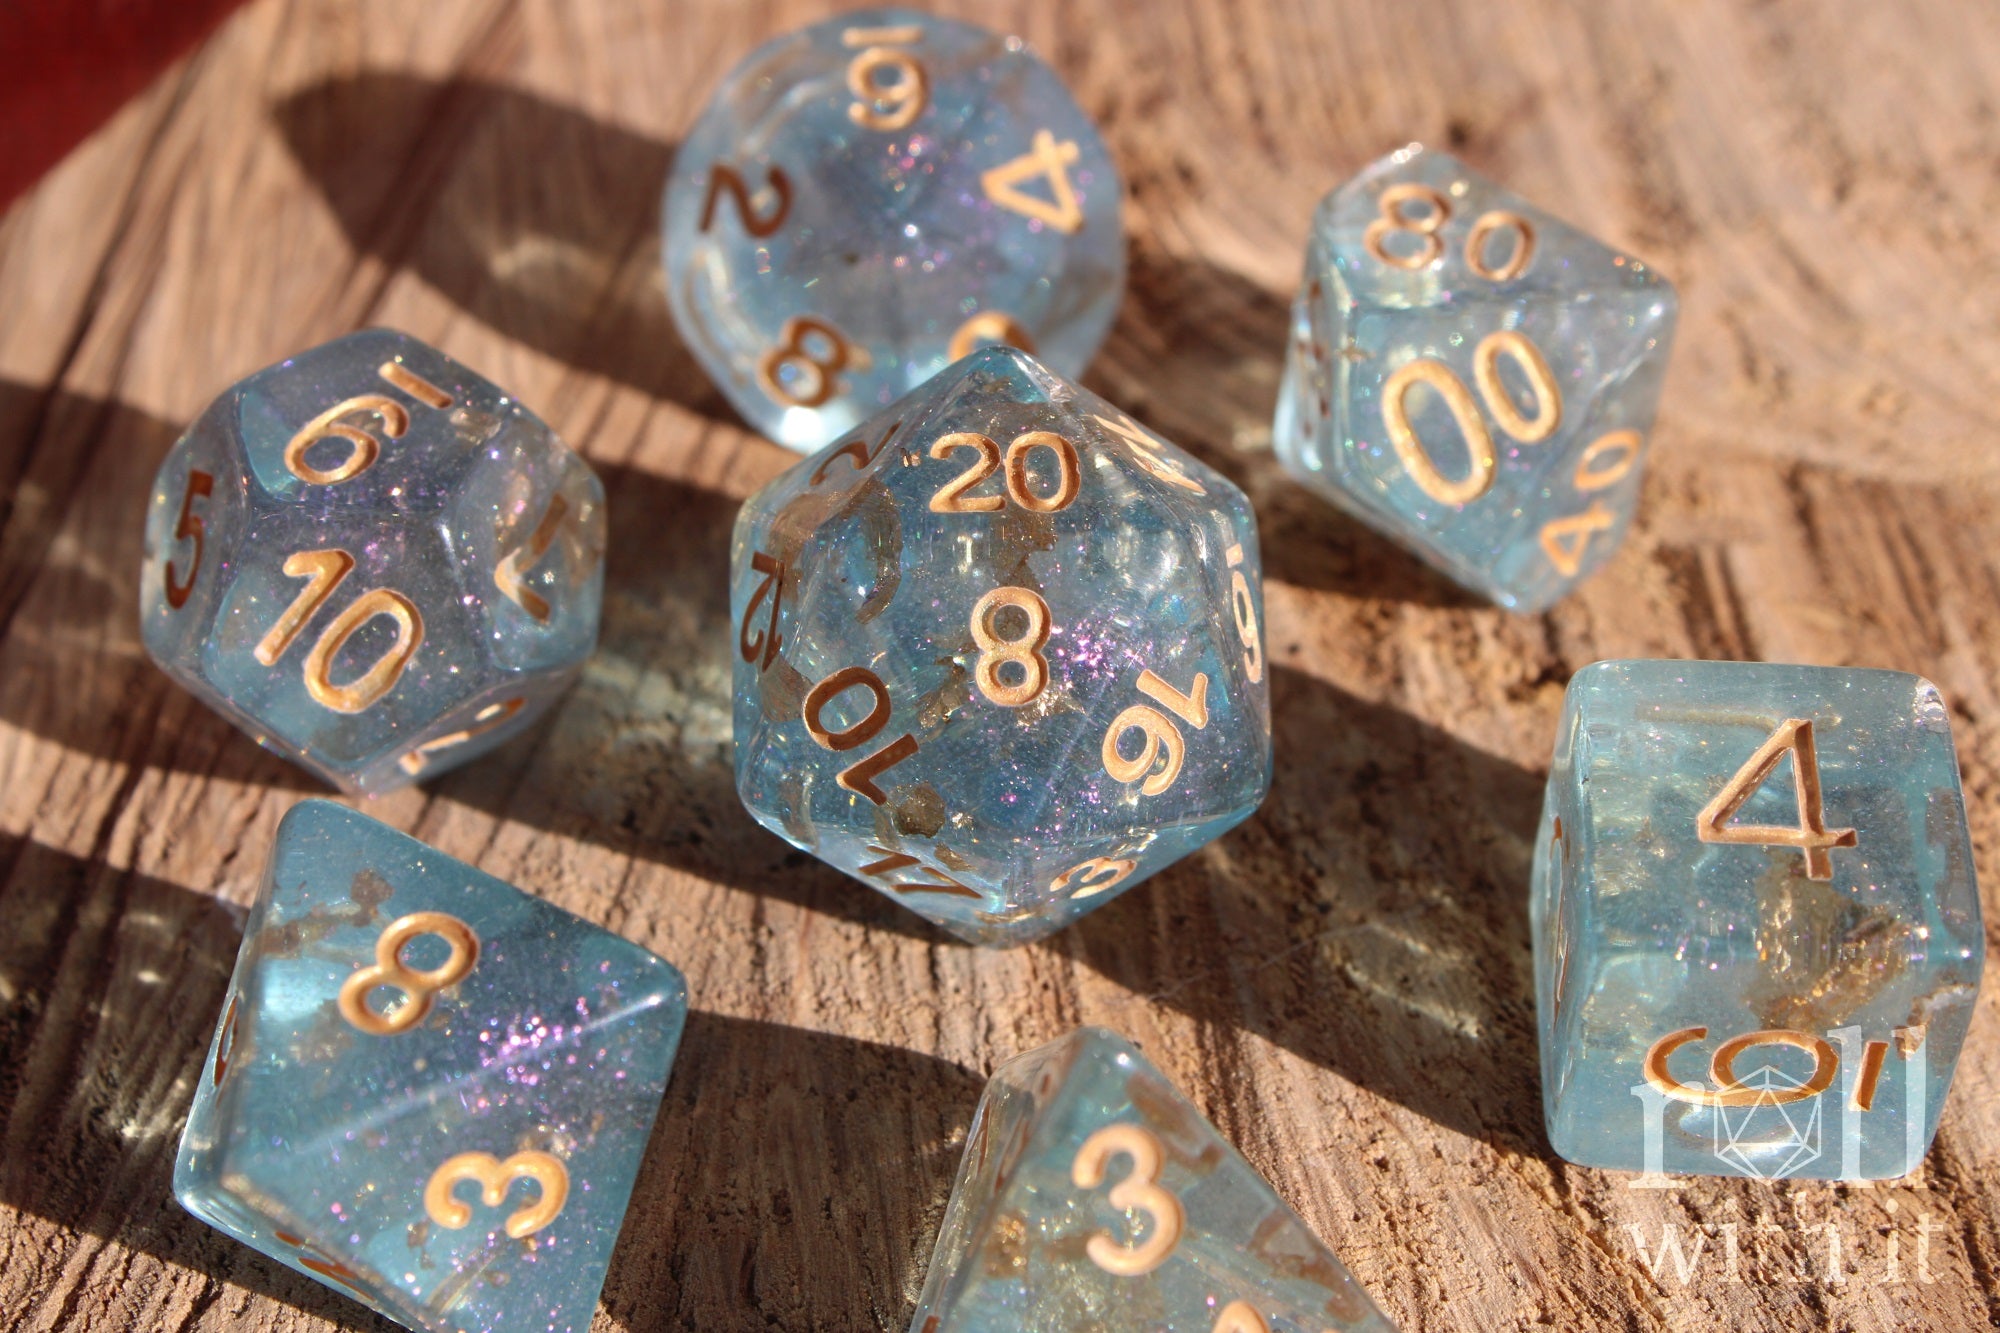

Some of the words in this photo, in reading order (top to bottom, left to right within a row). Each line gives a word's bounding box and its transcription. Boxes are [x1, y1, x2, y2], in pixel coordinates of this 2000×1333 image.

[698, 164, 792, 238] 2
[981, 130, 1084, 236] 4
[1363, 183, 1537, 283] 80
[757, 316, 852, 409] 8
[1381, 330, 1562, 506] 00
[930, 432, 1081, 512] 20
[165, 470, 214, 610] 5
[253, 549, 424, 714] 10
[970, 586, 1053, 707] 8
[803, 667, 918, 805] 10
[1102, 668, 1208, 796] 16
[1697, 718, 1859, 881] 4
[1050, 857, 1138, 899] 3
[338, 911, 481, 1035] 8
[424, 1150, 570, 1239] 3
[1072, 1122, 1188, 1277] 3
